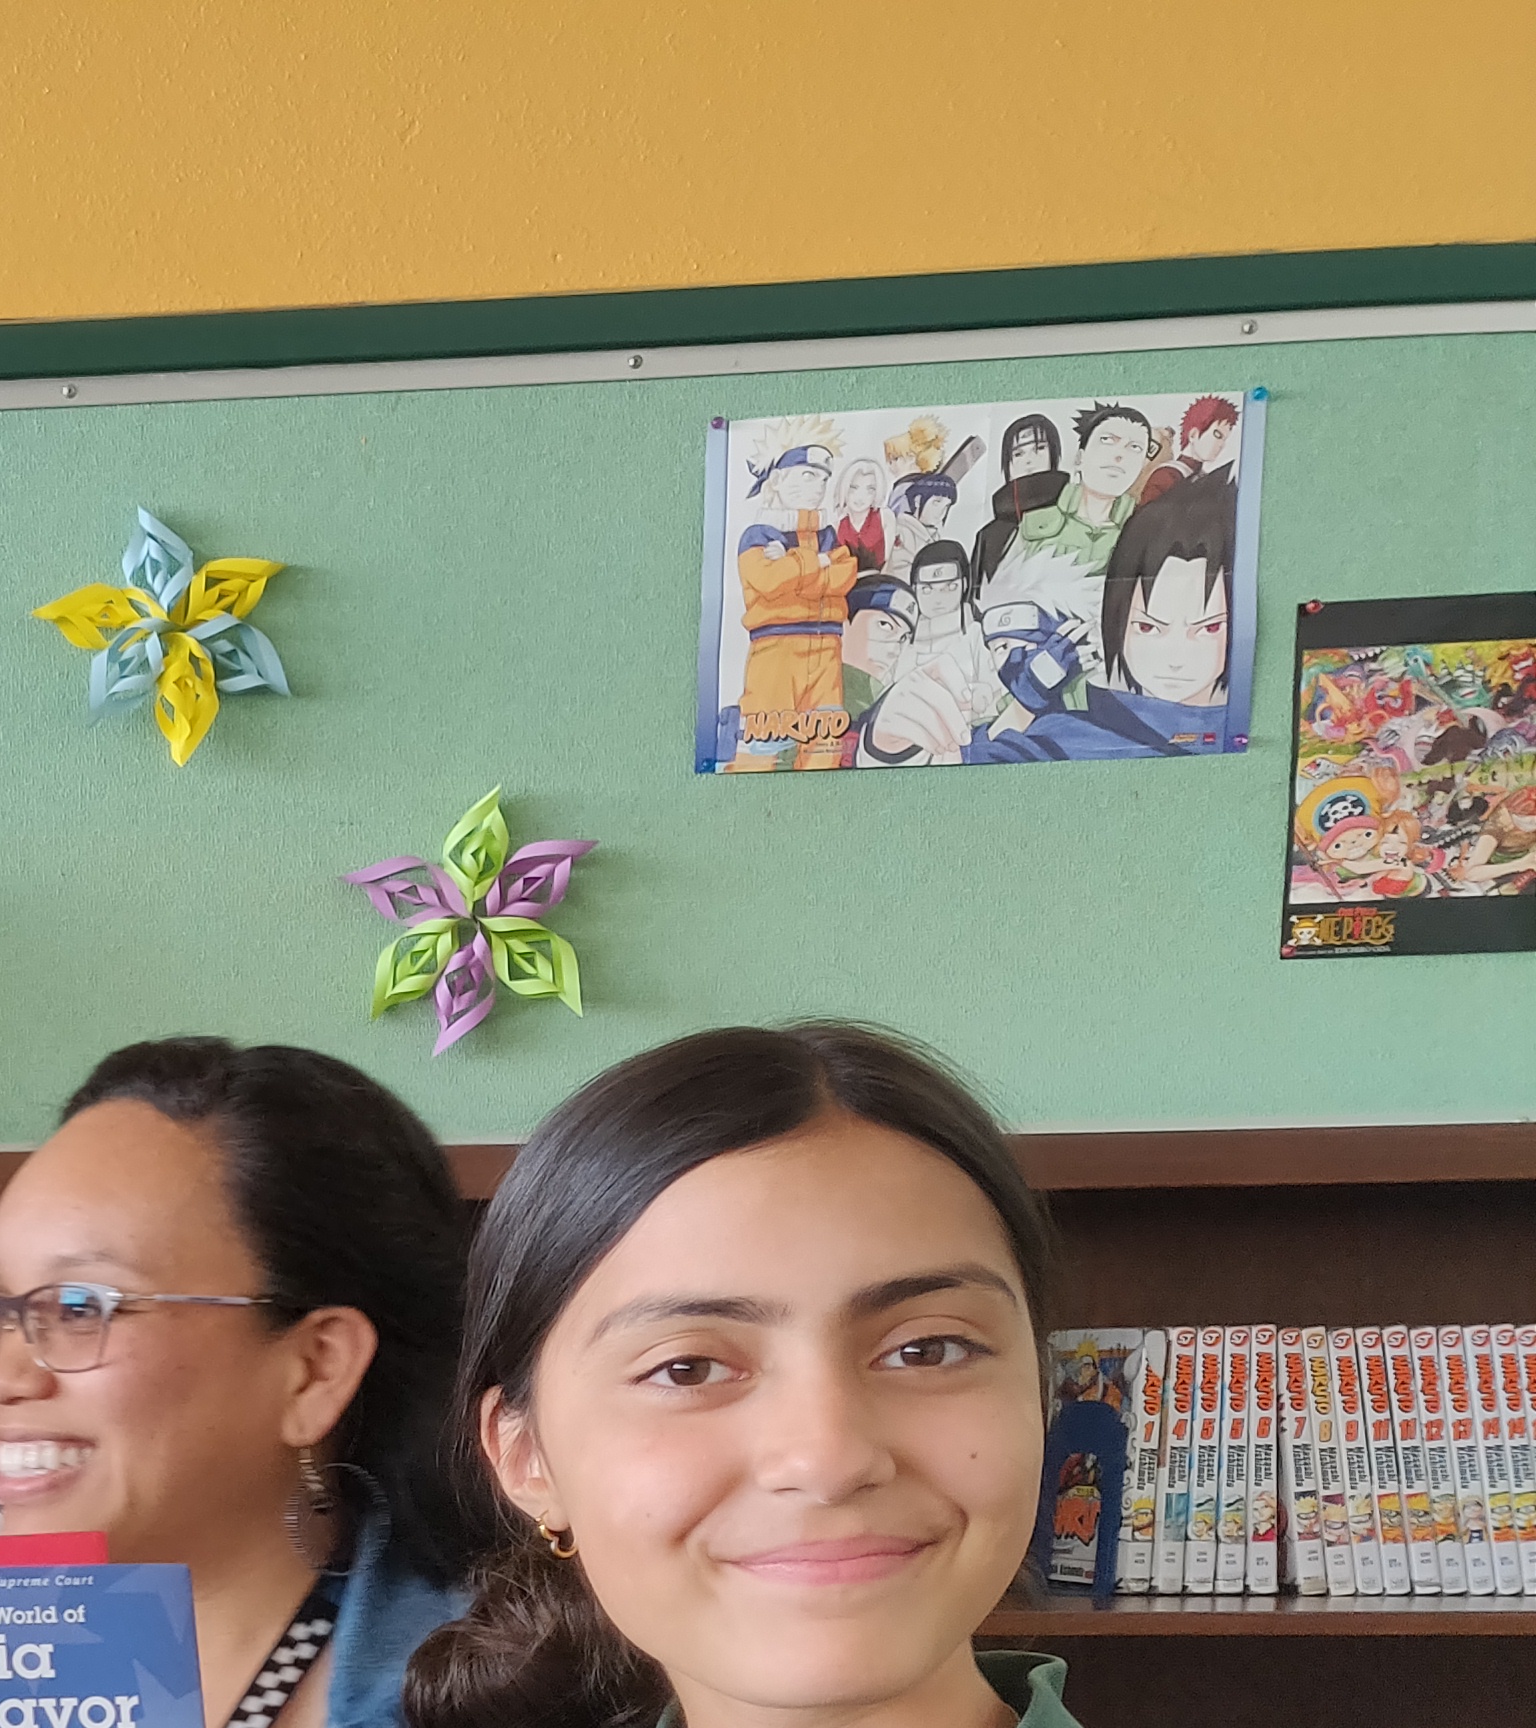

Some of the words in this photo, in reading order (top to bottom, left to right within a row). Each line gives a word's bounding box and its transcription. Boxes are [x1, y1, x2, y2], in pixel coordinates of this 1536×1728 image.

[744, 710, 852, 744] NARUTO
[1200, 1353, 1220, 1412] NARUTO
[1255, 1352, 1275, 1411] NARUTO
[1285, 1353, 1307, 1411] NARUTO
[1365, 1355, 1388, 1413] NARUTO
[1445, 1354, 1469, 1412] NARUTO
[1499, 1353, 1522, 1411] NARUTO
[1200, 1418, 1215, 1440] 5
[1257, 1417, 1272, 1438] 6
[1293, 1417, 1307, 1439] 7
[1372, 1418, 1390, 1441] 11
[1452, 1418, 1472, 1441] 13
[53, 1573, 94, 1587] Court
[63, 1604, 86, 1624] of
